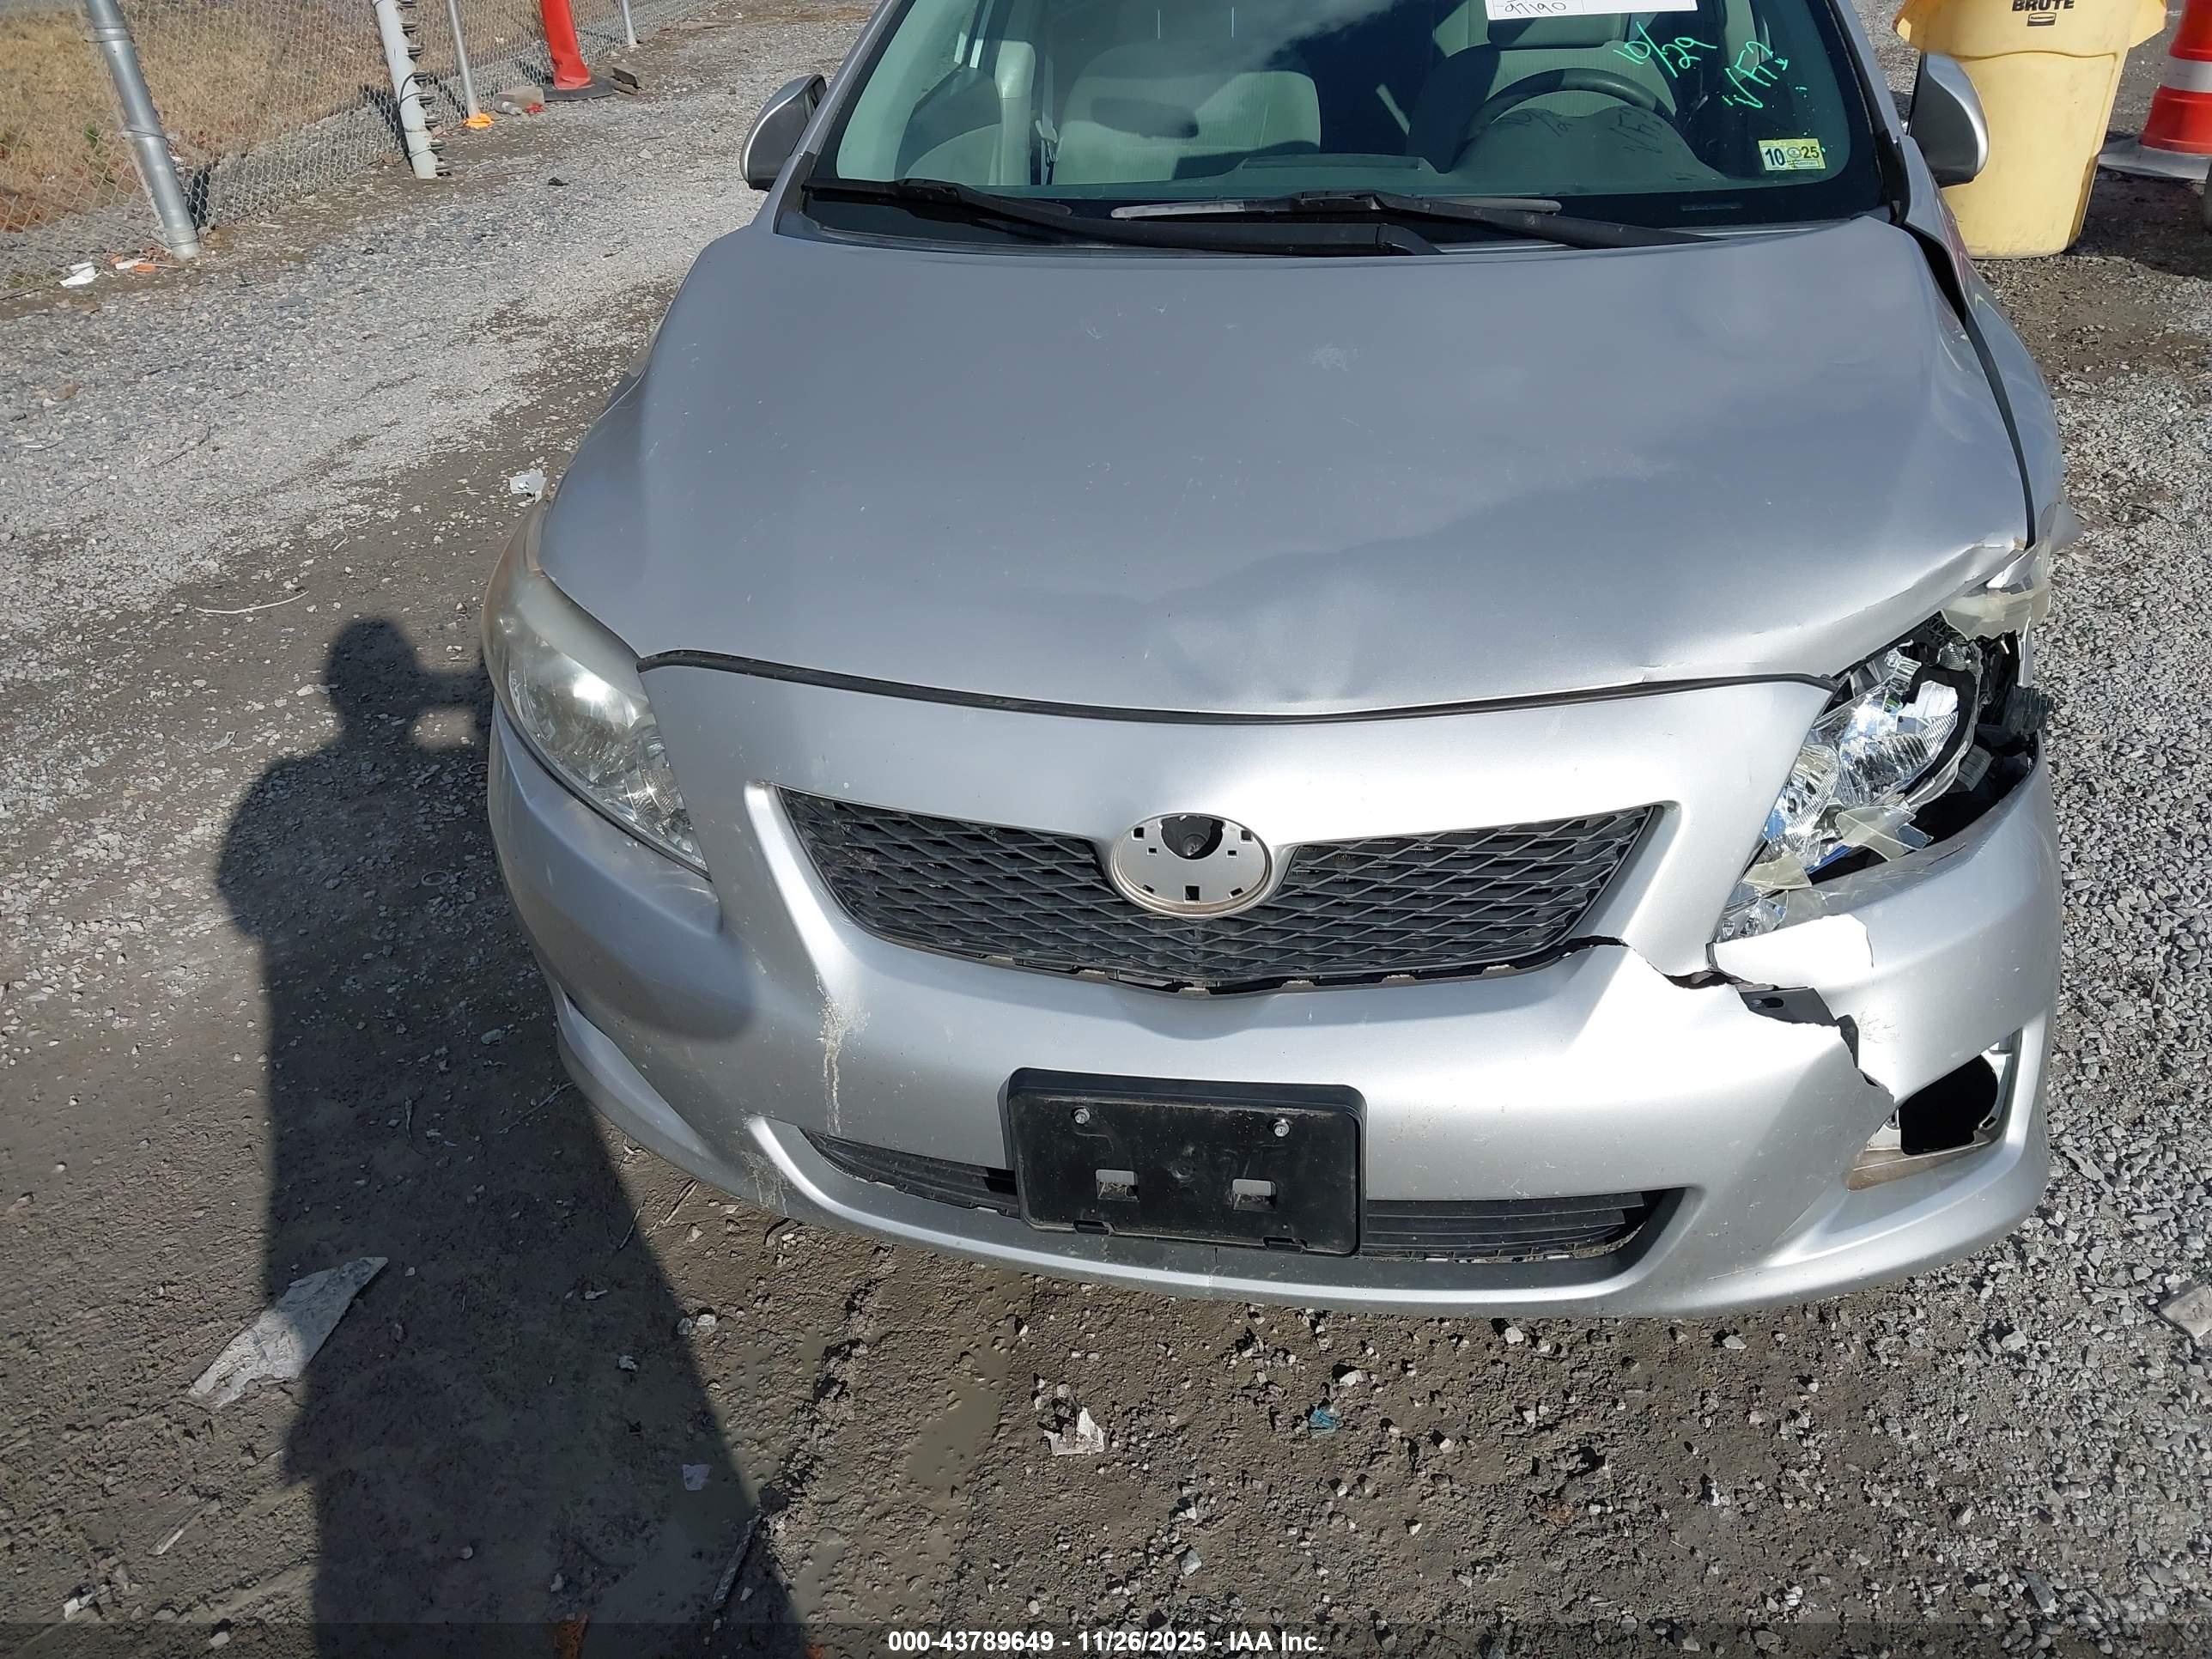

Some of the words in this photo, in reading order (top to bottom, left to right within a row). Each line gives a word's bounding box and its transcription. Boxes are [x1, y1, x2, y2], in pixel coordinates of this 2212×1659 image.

[2011, 0, 2075, 11] BRUTE
[1765, 148, 1786, 167] 10
[1801, 146, 1820, 159] 25
